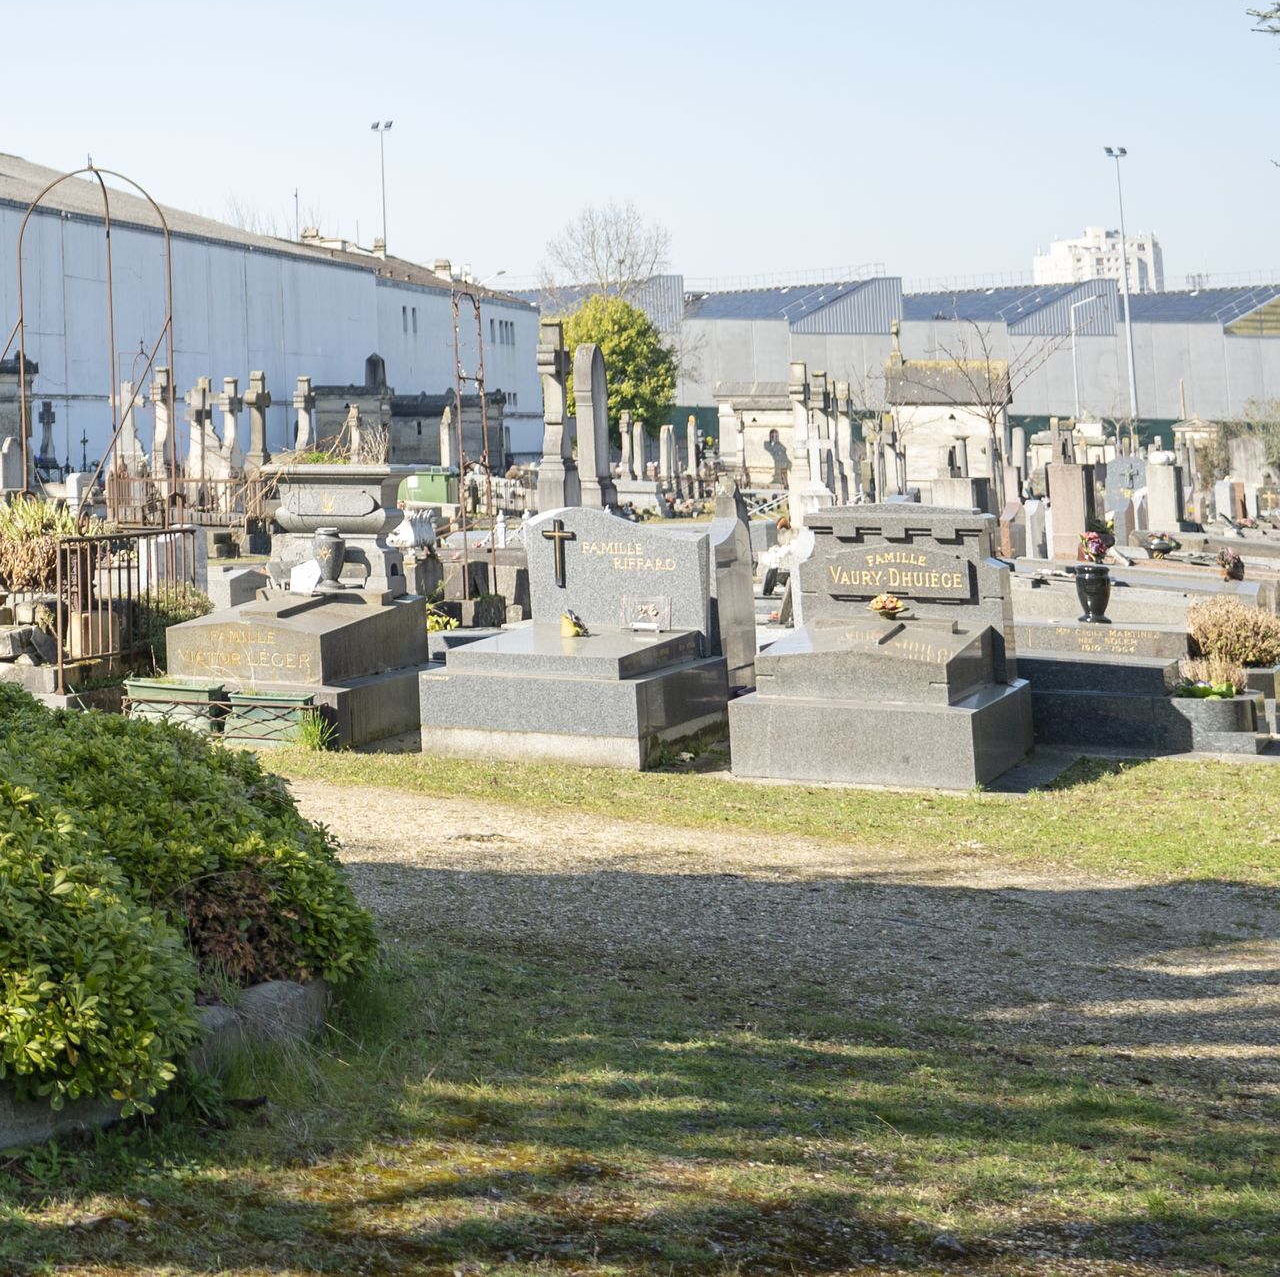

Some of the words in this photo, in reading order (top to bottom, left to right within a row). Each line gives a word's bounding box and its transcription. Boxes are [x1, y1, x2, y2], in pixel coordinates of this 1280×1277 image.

[581, 541, 644, 555] FAMILLE
[613, 557, 677, 571] RIFFARD
[865, 552, 927, 567] FAMILLE
[209, 629, 277, 645] FAMILLE
[176, 649, 242, 667] VICTOR
